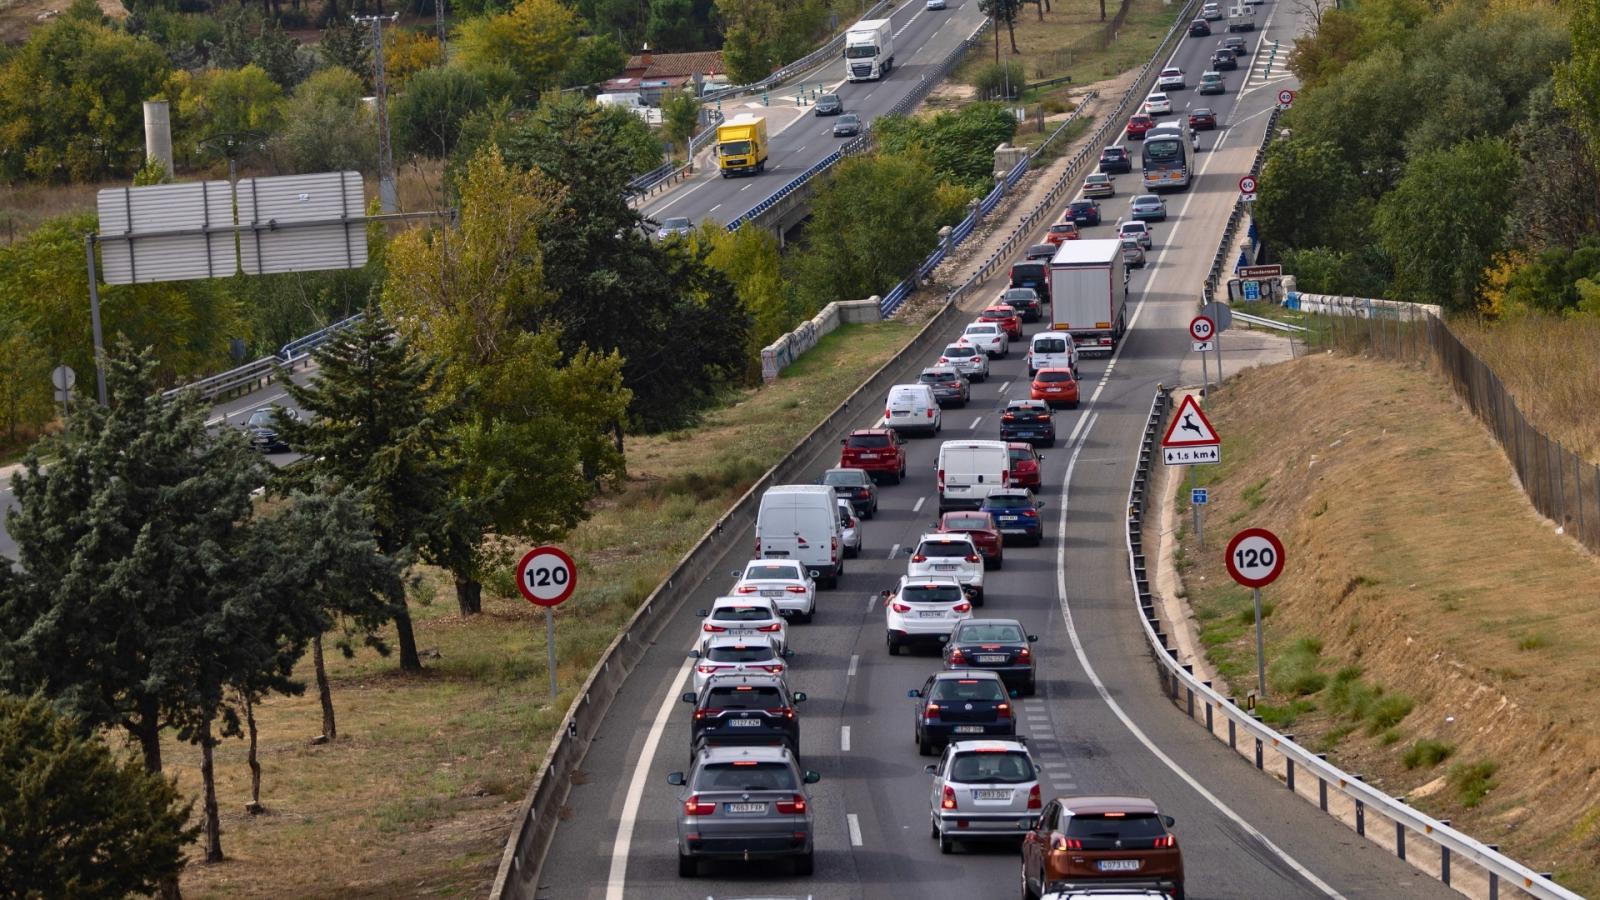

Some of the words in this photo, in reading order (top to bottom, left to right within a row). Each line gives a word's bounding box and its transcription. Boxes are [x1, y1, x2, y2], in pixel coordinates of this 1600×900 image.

[1195, 323, 1209, 333] 90
[1193, 450, 1208, 459] km
[1236, 547, 1274, 569] 120
[526, 566, 568, 587] 120
